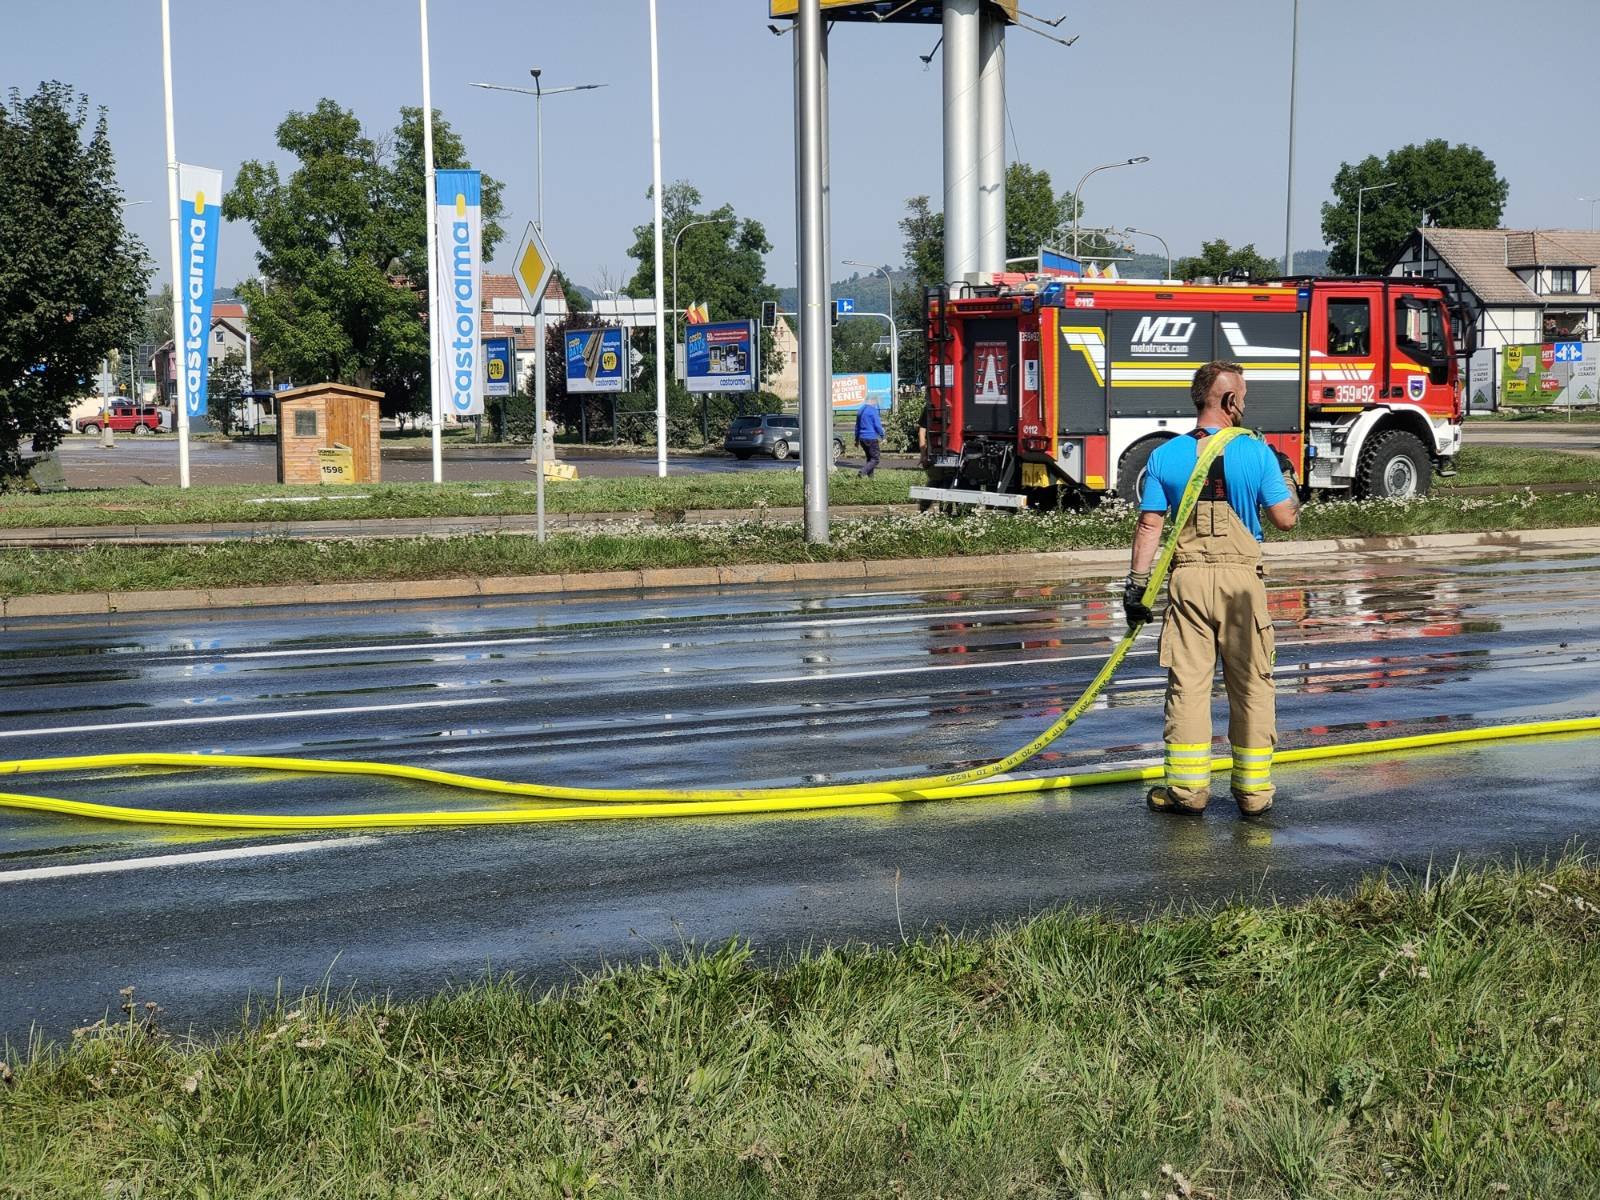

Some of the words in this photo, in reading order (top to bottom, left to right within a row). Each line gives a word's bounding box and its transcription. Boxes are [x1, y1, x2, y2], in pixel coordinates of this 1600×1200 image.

[186, 218, 207, 412] castorama
[452, 221, 473, 411] castorama
[1130, 343, 1189, 353] mototruck.com
[322, 466, 343, 474] 1598
